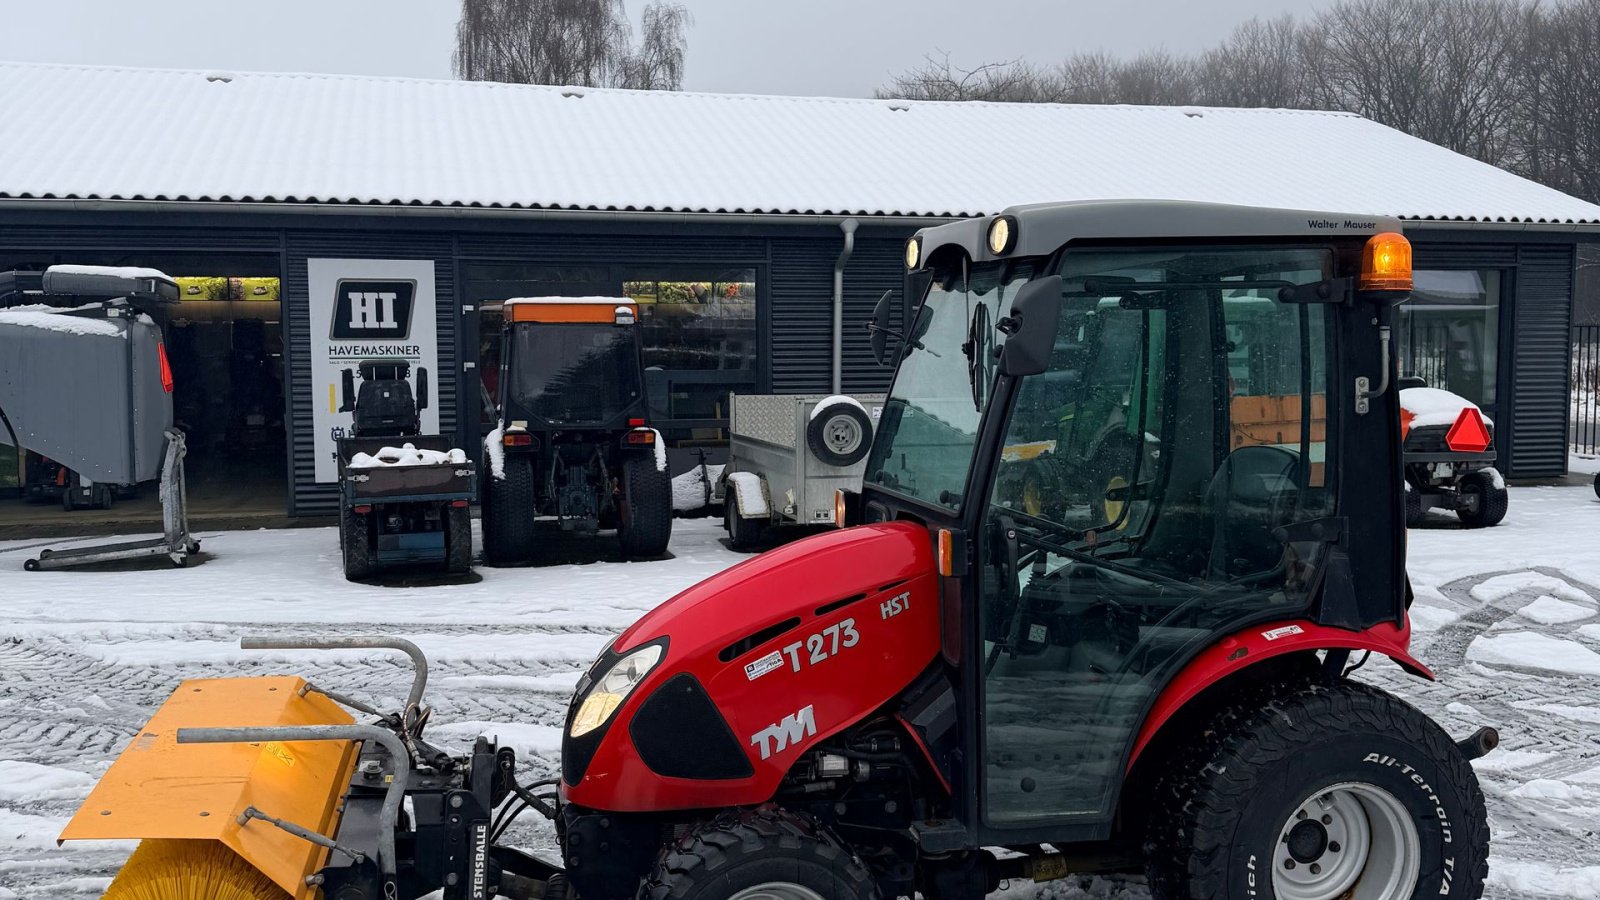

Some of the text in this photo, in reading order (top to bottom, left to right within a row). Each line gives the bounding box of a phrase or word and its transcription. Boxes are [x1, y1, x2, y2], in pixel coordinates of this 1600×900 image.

[1308, 219, 1376, 229] Walter Mauser
[348, 292, 398, 328] HI
[329, 345, 420, 355] HAVEMASKINER
[880, 592, 911, 620] HST
[751, 704, 817, 760] TYM
[1363, 752, 1455, 895] All-Terrain T/A
